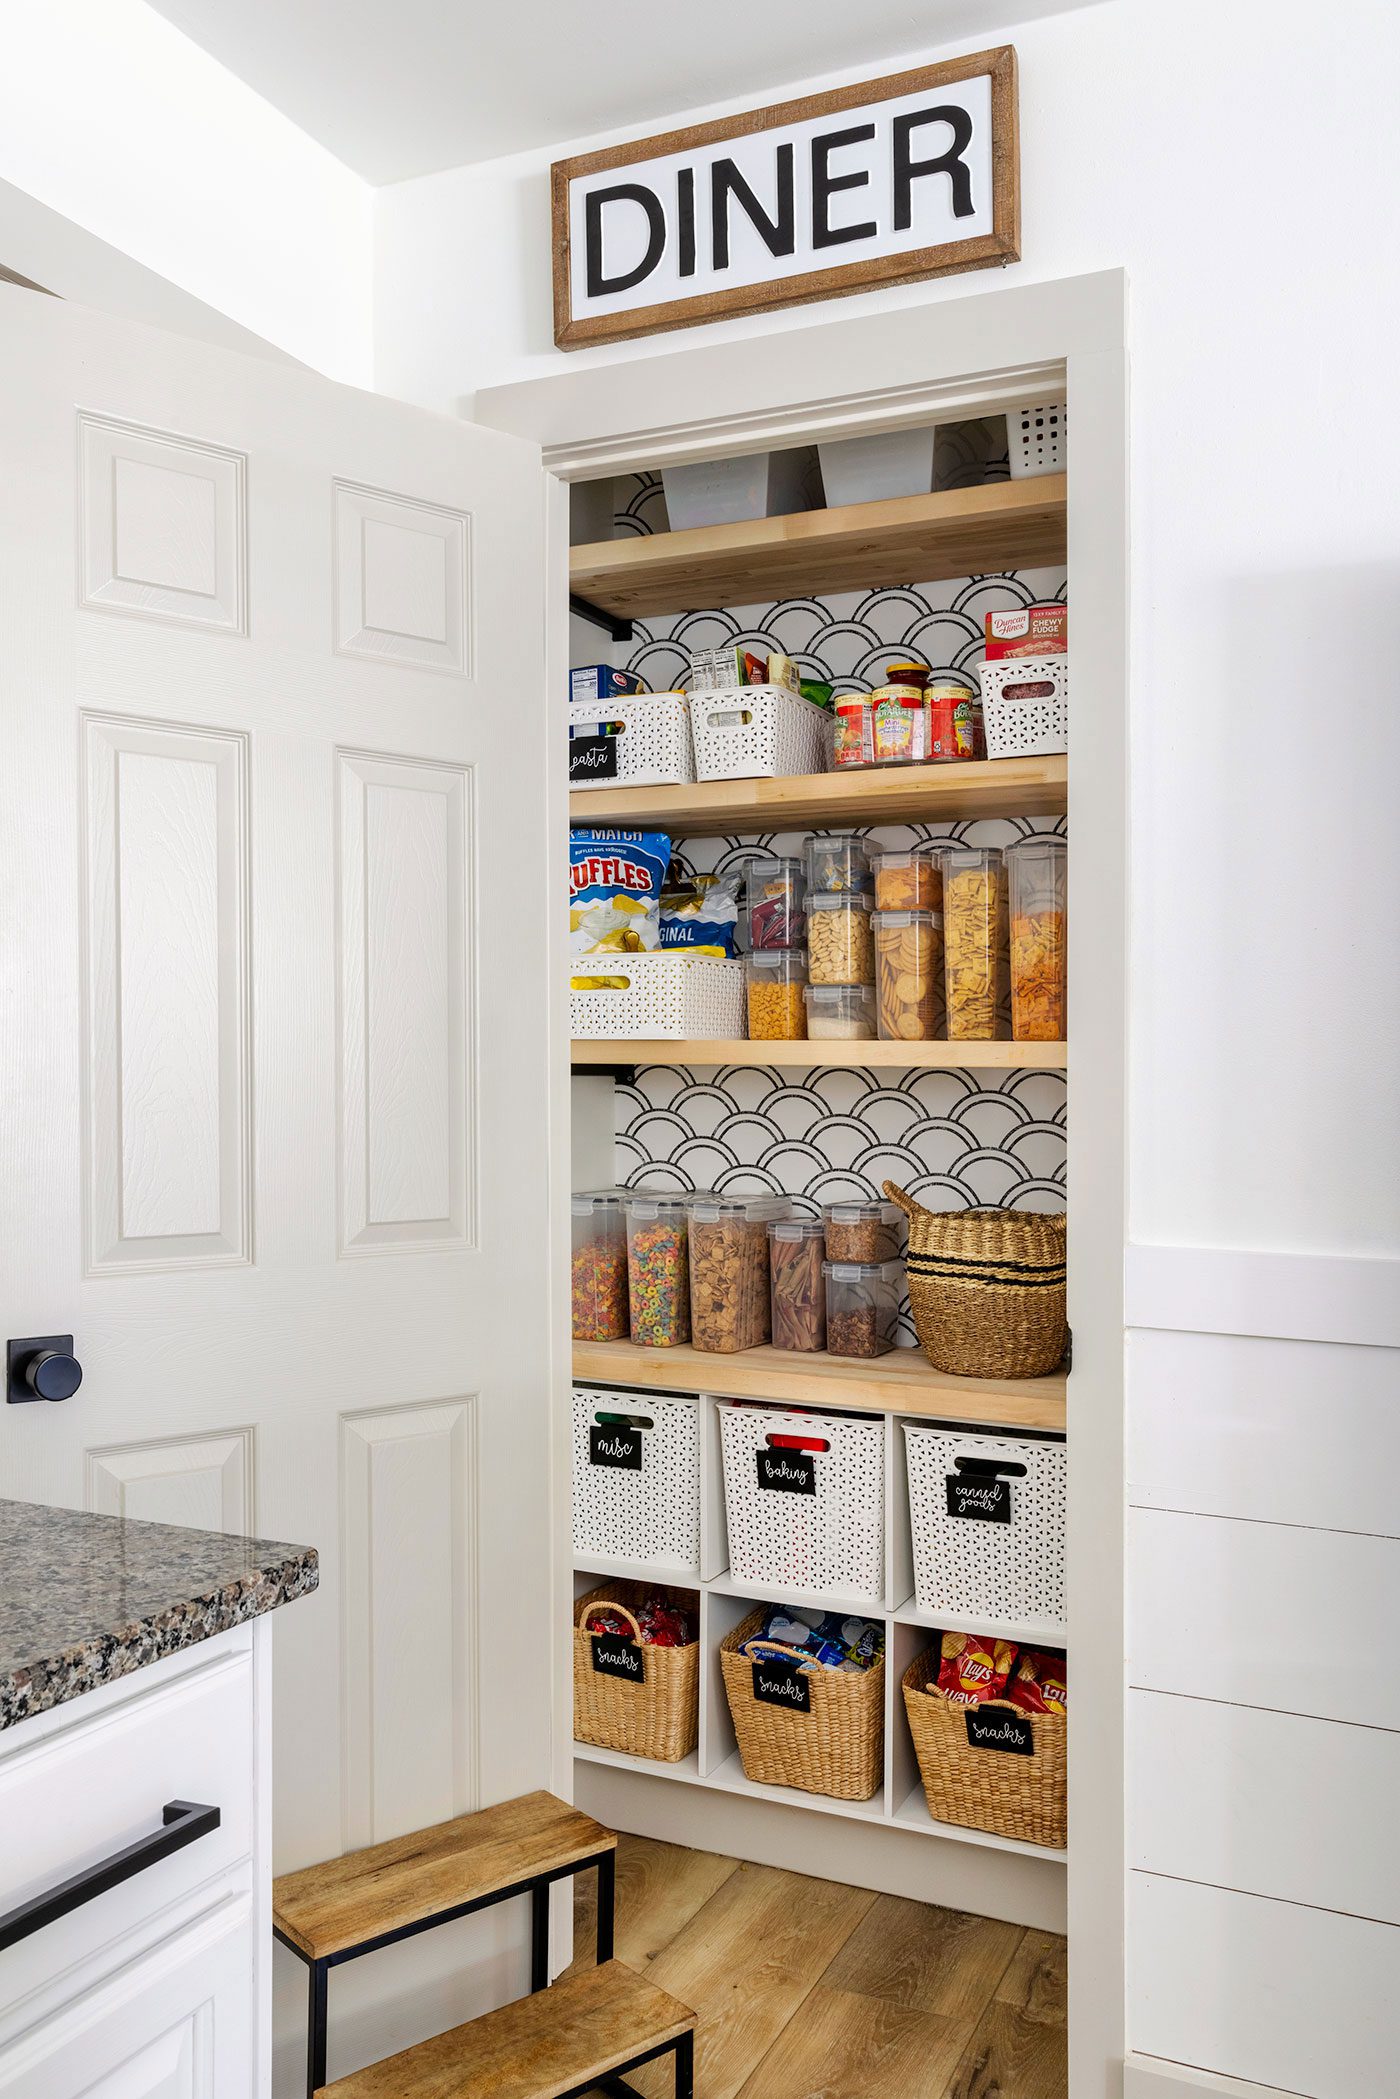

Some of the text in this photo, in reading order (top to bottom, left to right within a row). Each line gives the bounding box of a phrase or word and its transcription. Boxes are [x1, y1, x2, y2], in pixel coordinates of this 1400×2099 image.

[586, 105, 976, 298] DINER
[994, 615, 1026, 629] Duncan
[999, 623, 1024, 635] Hines
[1032, 618, 1063, 627] CHEWY
[1032, 625, 1059, 634] FUDGE
[569, 746, 608, 772] pasta
[591, 829, 643, 842] MATCH
[598, 1437, 633, 1458] misc
[765, 1459, 809, 1485] baking
[955, 1484, 1003, 1502] canned
[958, 1496, 996, 1512] goods
[597, 1647, 639, 1672] snacks
[962, 1659, 994, 1682] Lay's
[759, 1675, 806, 1702] snacks
[972, 1722, 1026, 1745] snacks
